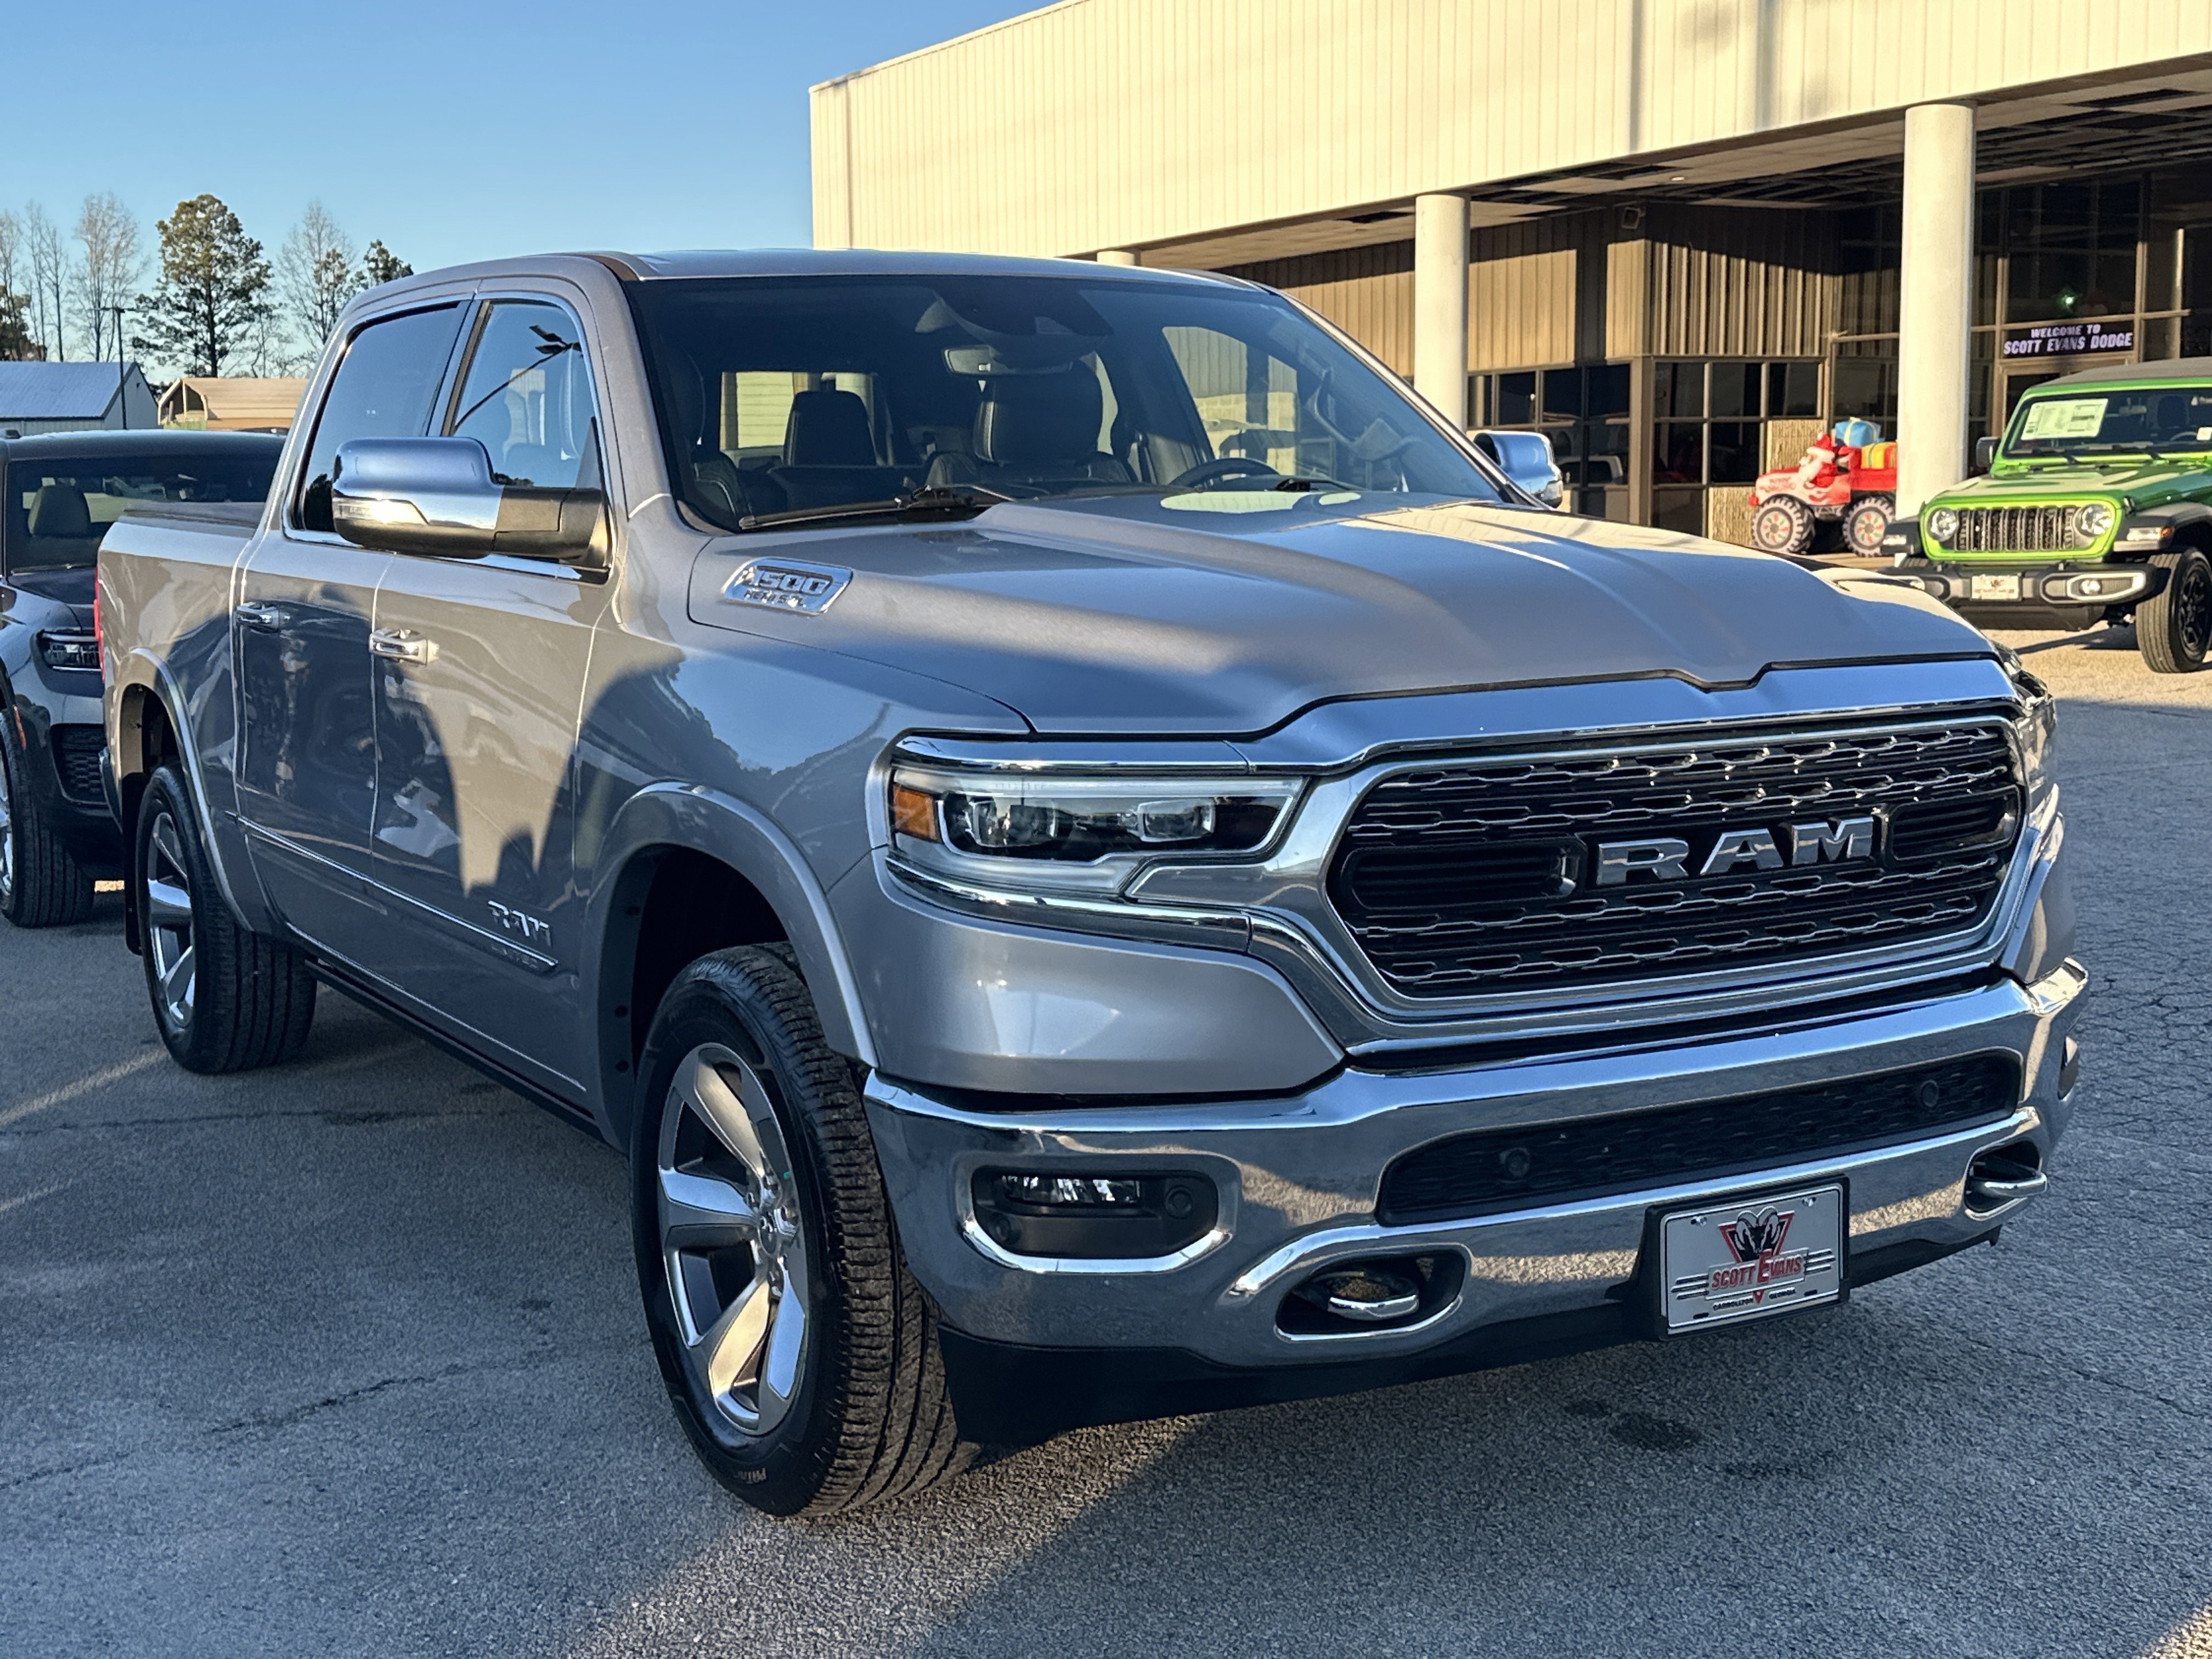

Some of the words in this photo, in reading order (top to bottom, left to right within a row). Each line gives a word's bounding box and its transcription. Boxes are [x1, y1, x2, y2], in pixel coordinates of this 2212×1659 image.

[2004, 340, 2041, 354] SCOTT
[2047, 337, 2085, 352] EVANS
[2090, 332, 2132, 349] DODGE
[2031, 325, 2082, 338] WELCOME
[2087, 324, 2101, 334] TO
[1596, 817, 1874, 885] RAM
[487, 900, 552, 948] RAM
[1712, 1264, 1756, 1288] SCOTT
[1757, 1249, 1801, 1283] EVANS
